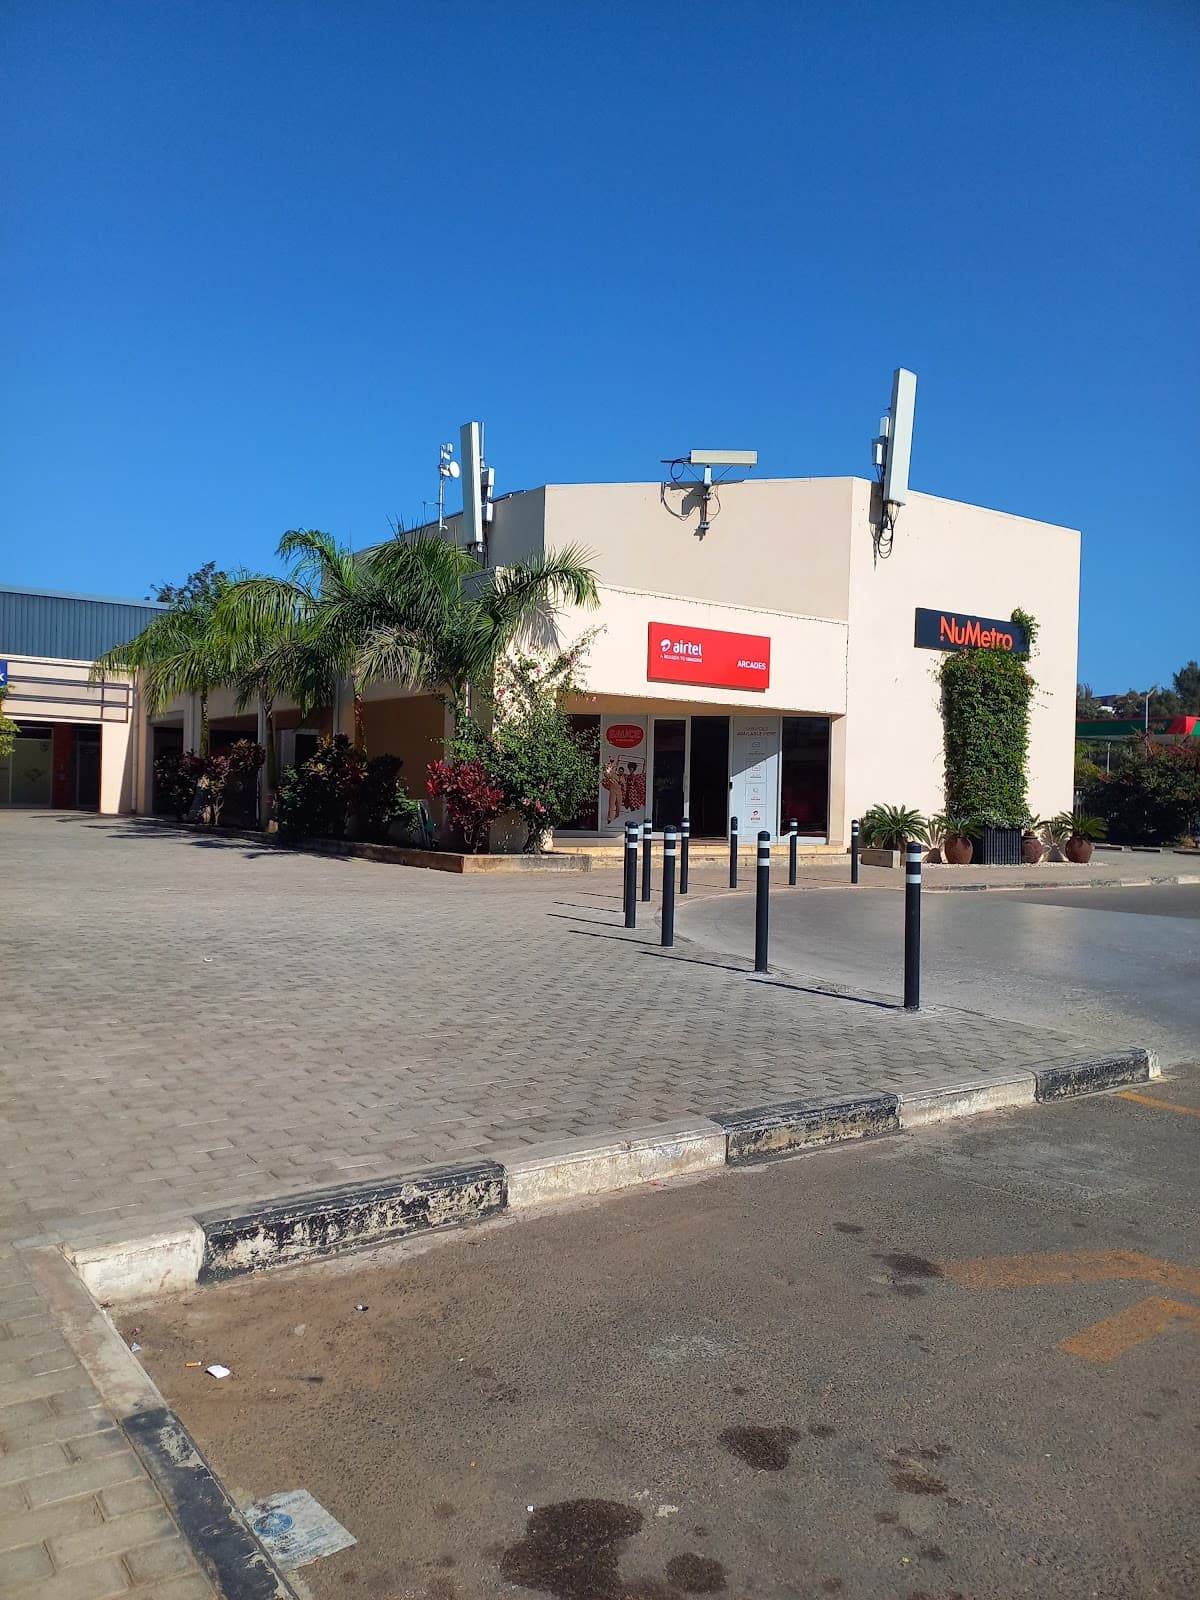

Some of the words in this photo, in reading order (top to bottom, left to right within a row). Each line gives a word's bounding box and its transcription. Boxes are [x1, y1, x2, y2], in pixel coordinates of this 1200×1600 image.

[940, 615, 1013, 650] NuMetro
[673, 640, 702, 656] airtel
[737, 660, 766, 670] ARCADES
